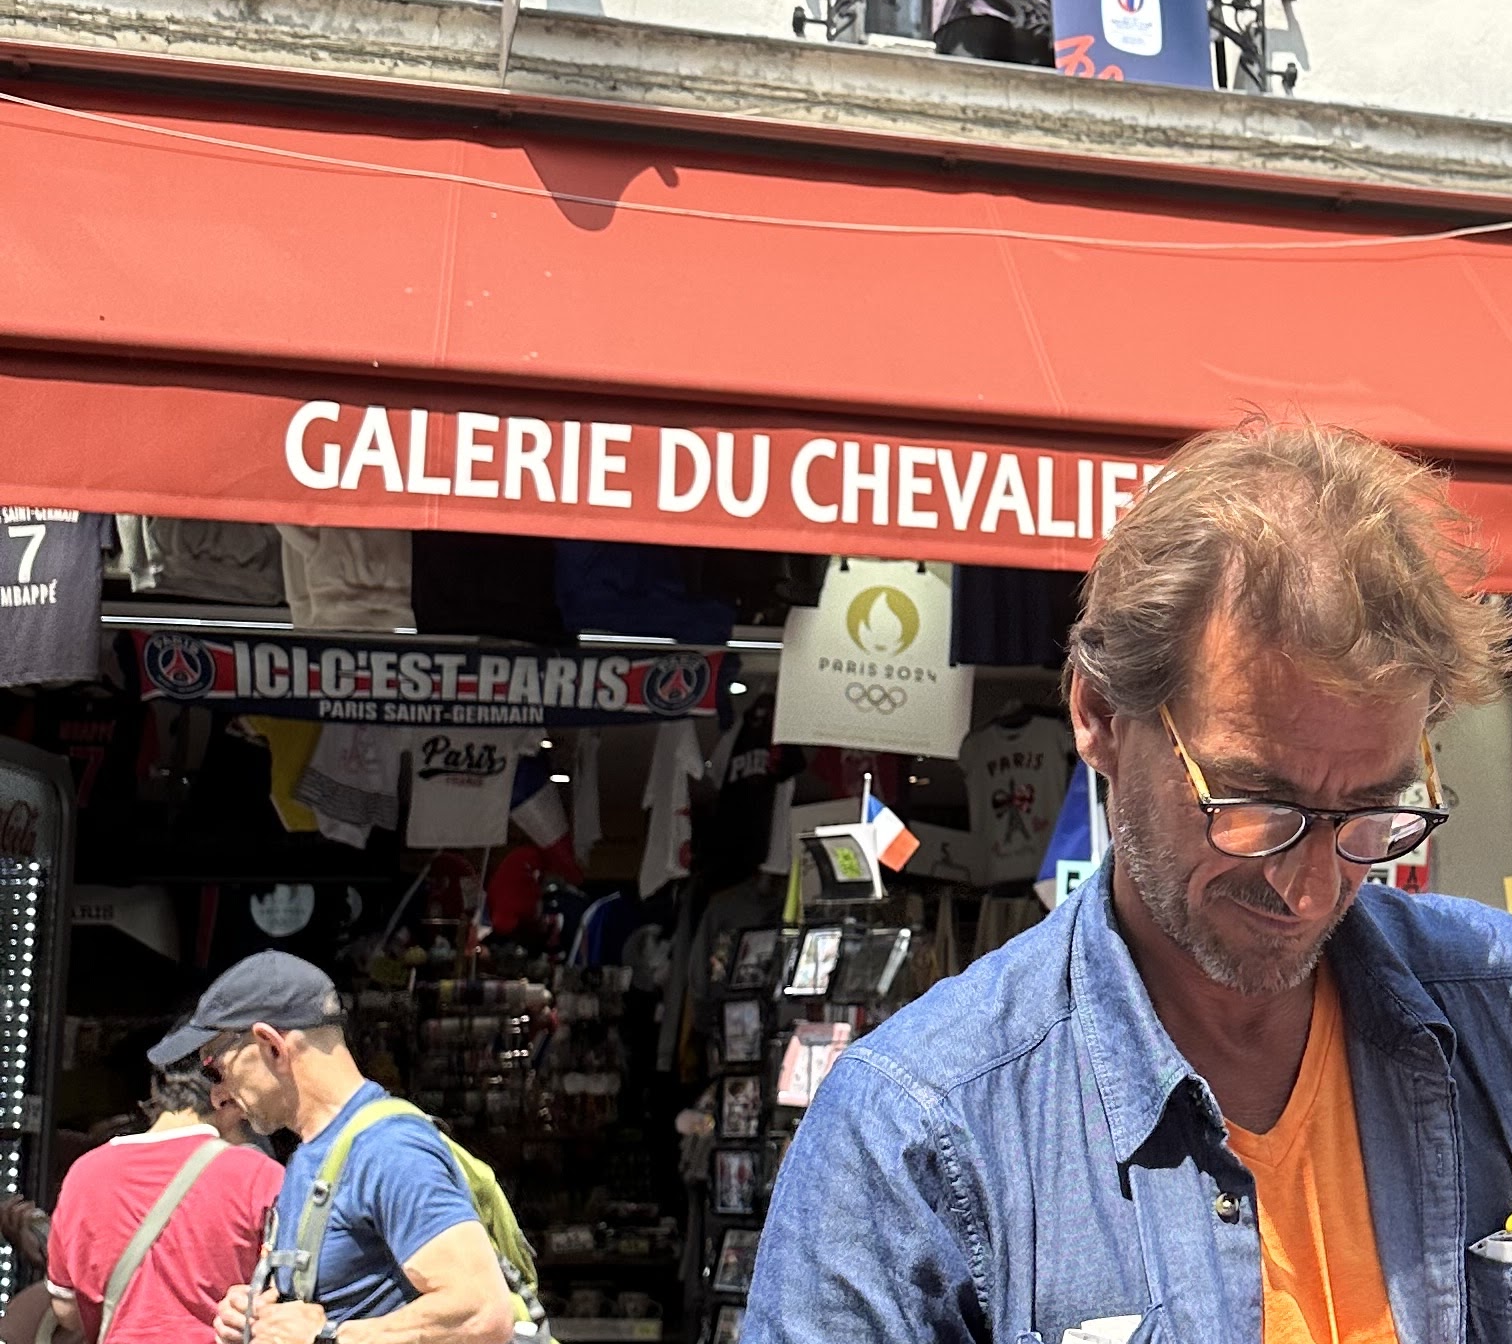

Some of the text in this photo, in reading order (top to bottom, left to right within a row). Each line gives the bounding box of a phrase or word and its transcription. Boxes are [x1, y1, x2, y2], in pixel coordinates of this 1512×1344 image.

[285, 400, 1172, 540] GALERIE DU CHEVALIE
[8, 524, 46, 584] 7
[235, 642, 630, 711] ICI C'EST PARIS
[818, 656, 878, 677] PARIS
[319, 702, 544, 724] PARIS SAINT-GERMAIN
[420, 734, 507, 778] Paris
